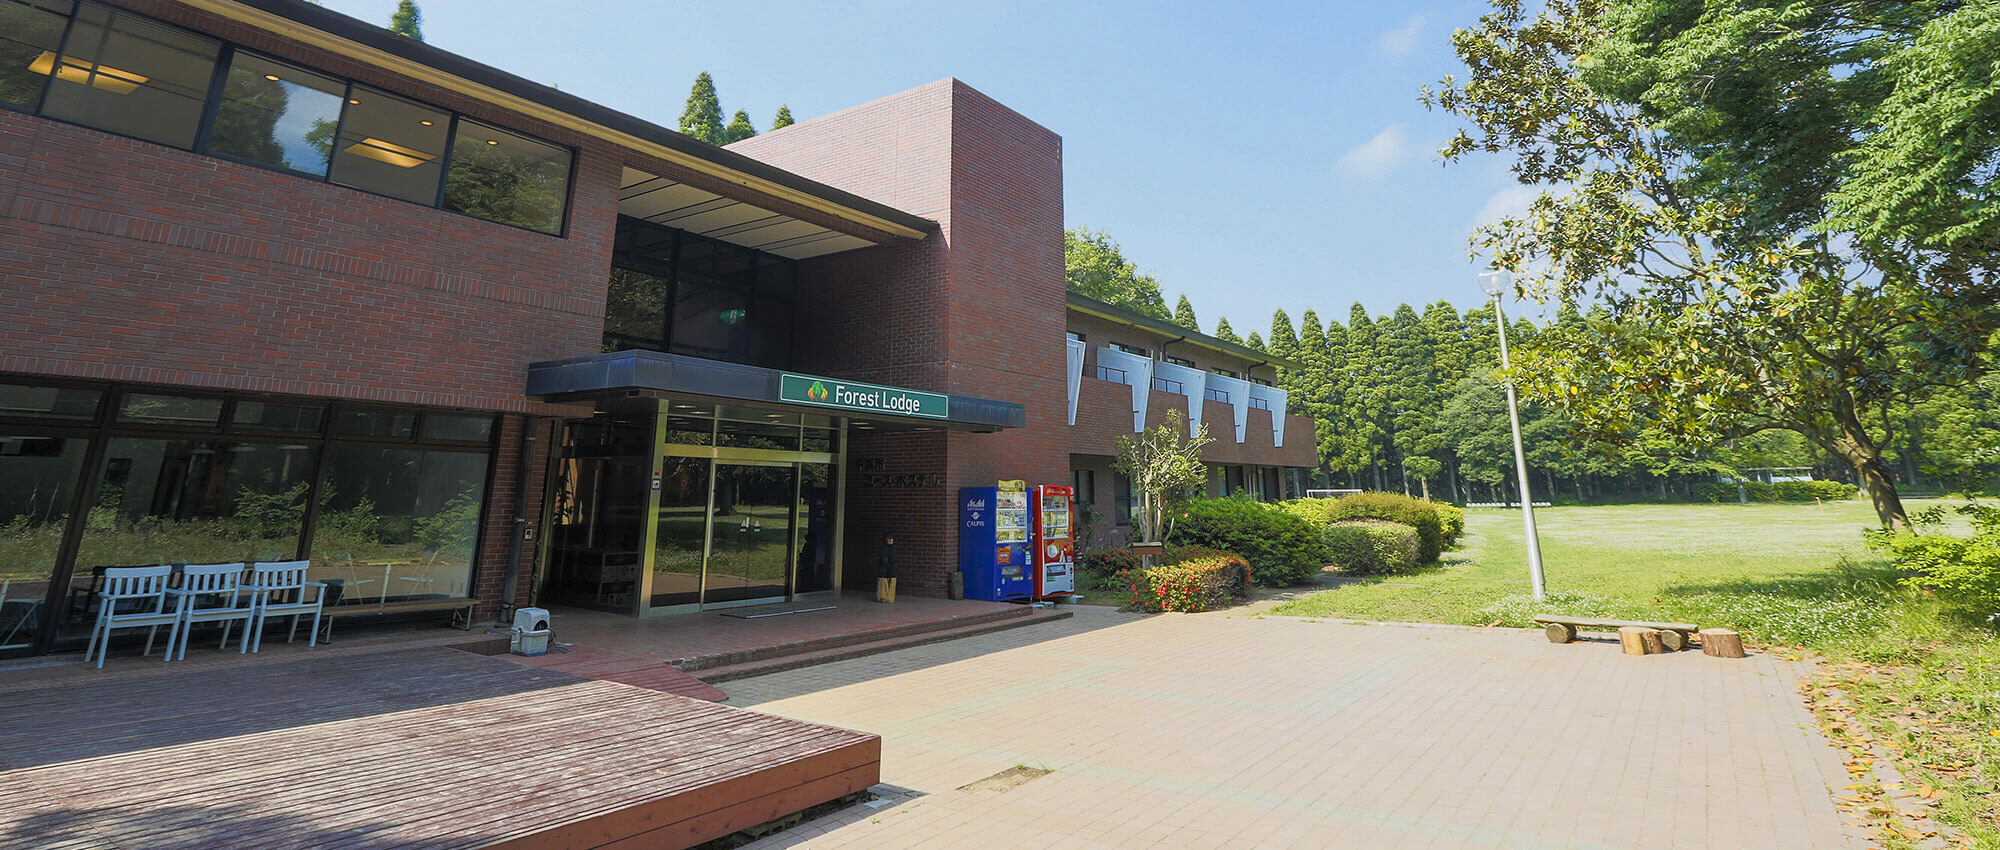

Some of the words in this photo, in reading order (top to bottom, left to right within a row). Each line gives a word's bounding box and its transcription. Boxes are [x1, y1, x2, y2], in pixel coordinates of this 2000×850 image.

[835, 385, 880, 407] Forest
[882, 391, 921, 415] Lodge
[966, 499, 985, 508] Asahi
